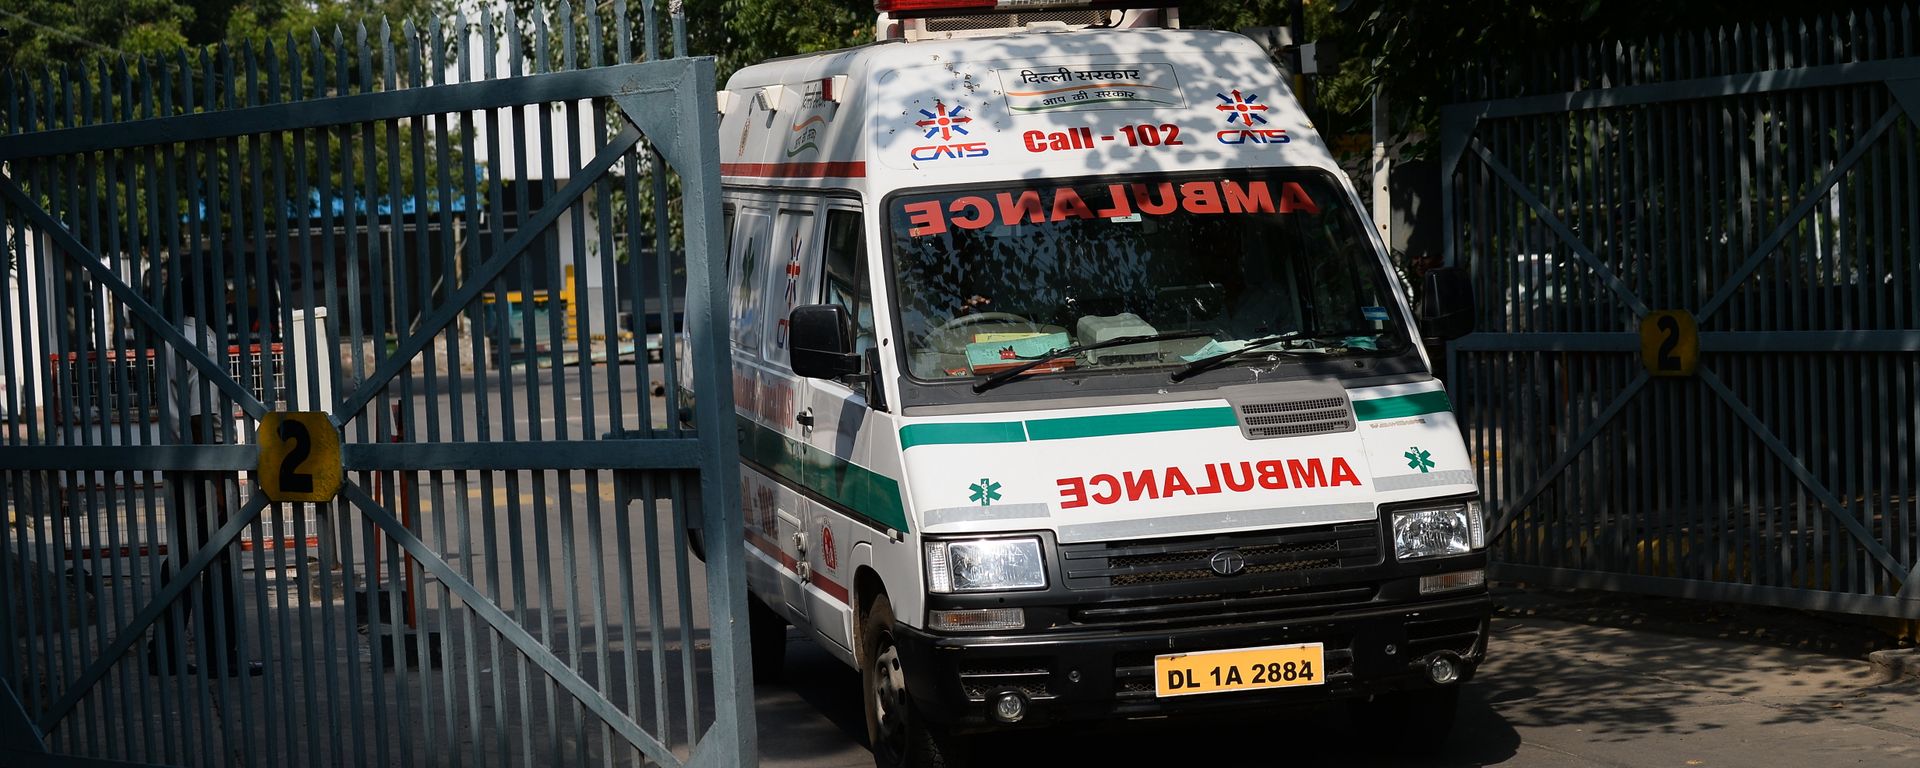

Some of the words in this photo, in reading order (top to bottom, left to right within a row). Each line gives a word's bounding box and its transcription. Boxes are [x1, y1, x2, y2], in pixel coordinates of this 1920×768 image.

[1021, 67, 1073, 84] दिल्ली
[1074, 69, 1140, 81] सरकार
[1042, 96, 1066, 106] आप
[1072, 90, 1089, 100] की
[1094, 90, 1136, 99] सरकार
[1023, 127, 1095, 153] Call
[1119, 123, 1184, 147] 102
[1216, 129, 1290, 145] CATS
[910, 142, 989, 161] CATS
[1657, 315, 1682, 371] 2
[277, 419, 312, 493] 2
[1167, 668, 1201, 690] DL
[1210, 665, 1242, 687] 1A
[1250, 660, 1314, 684] 2884
